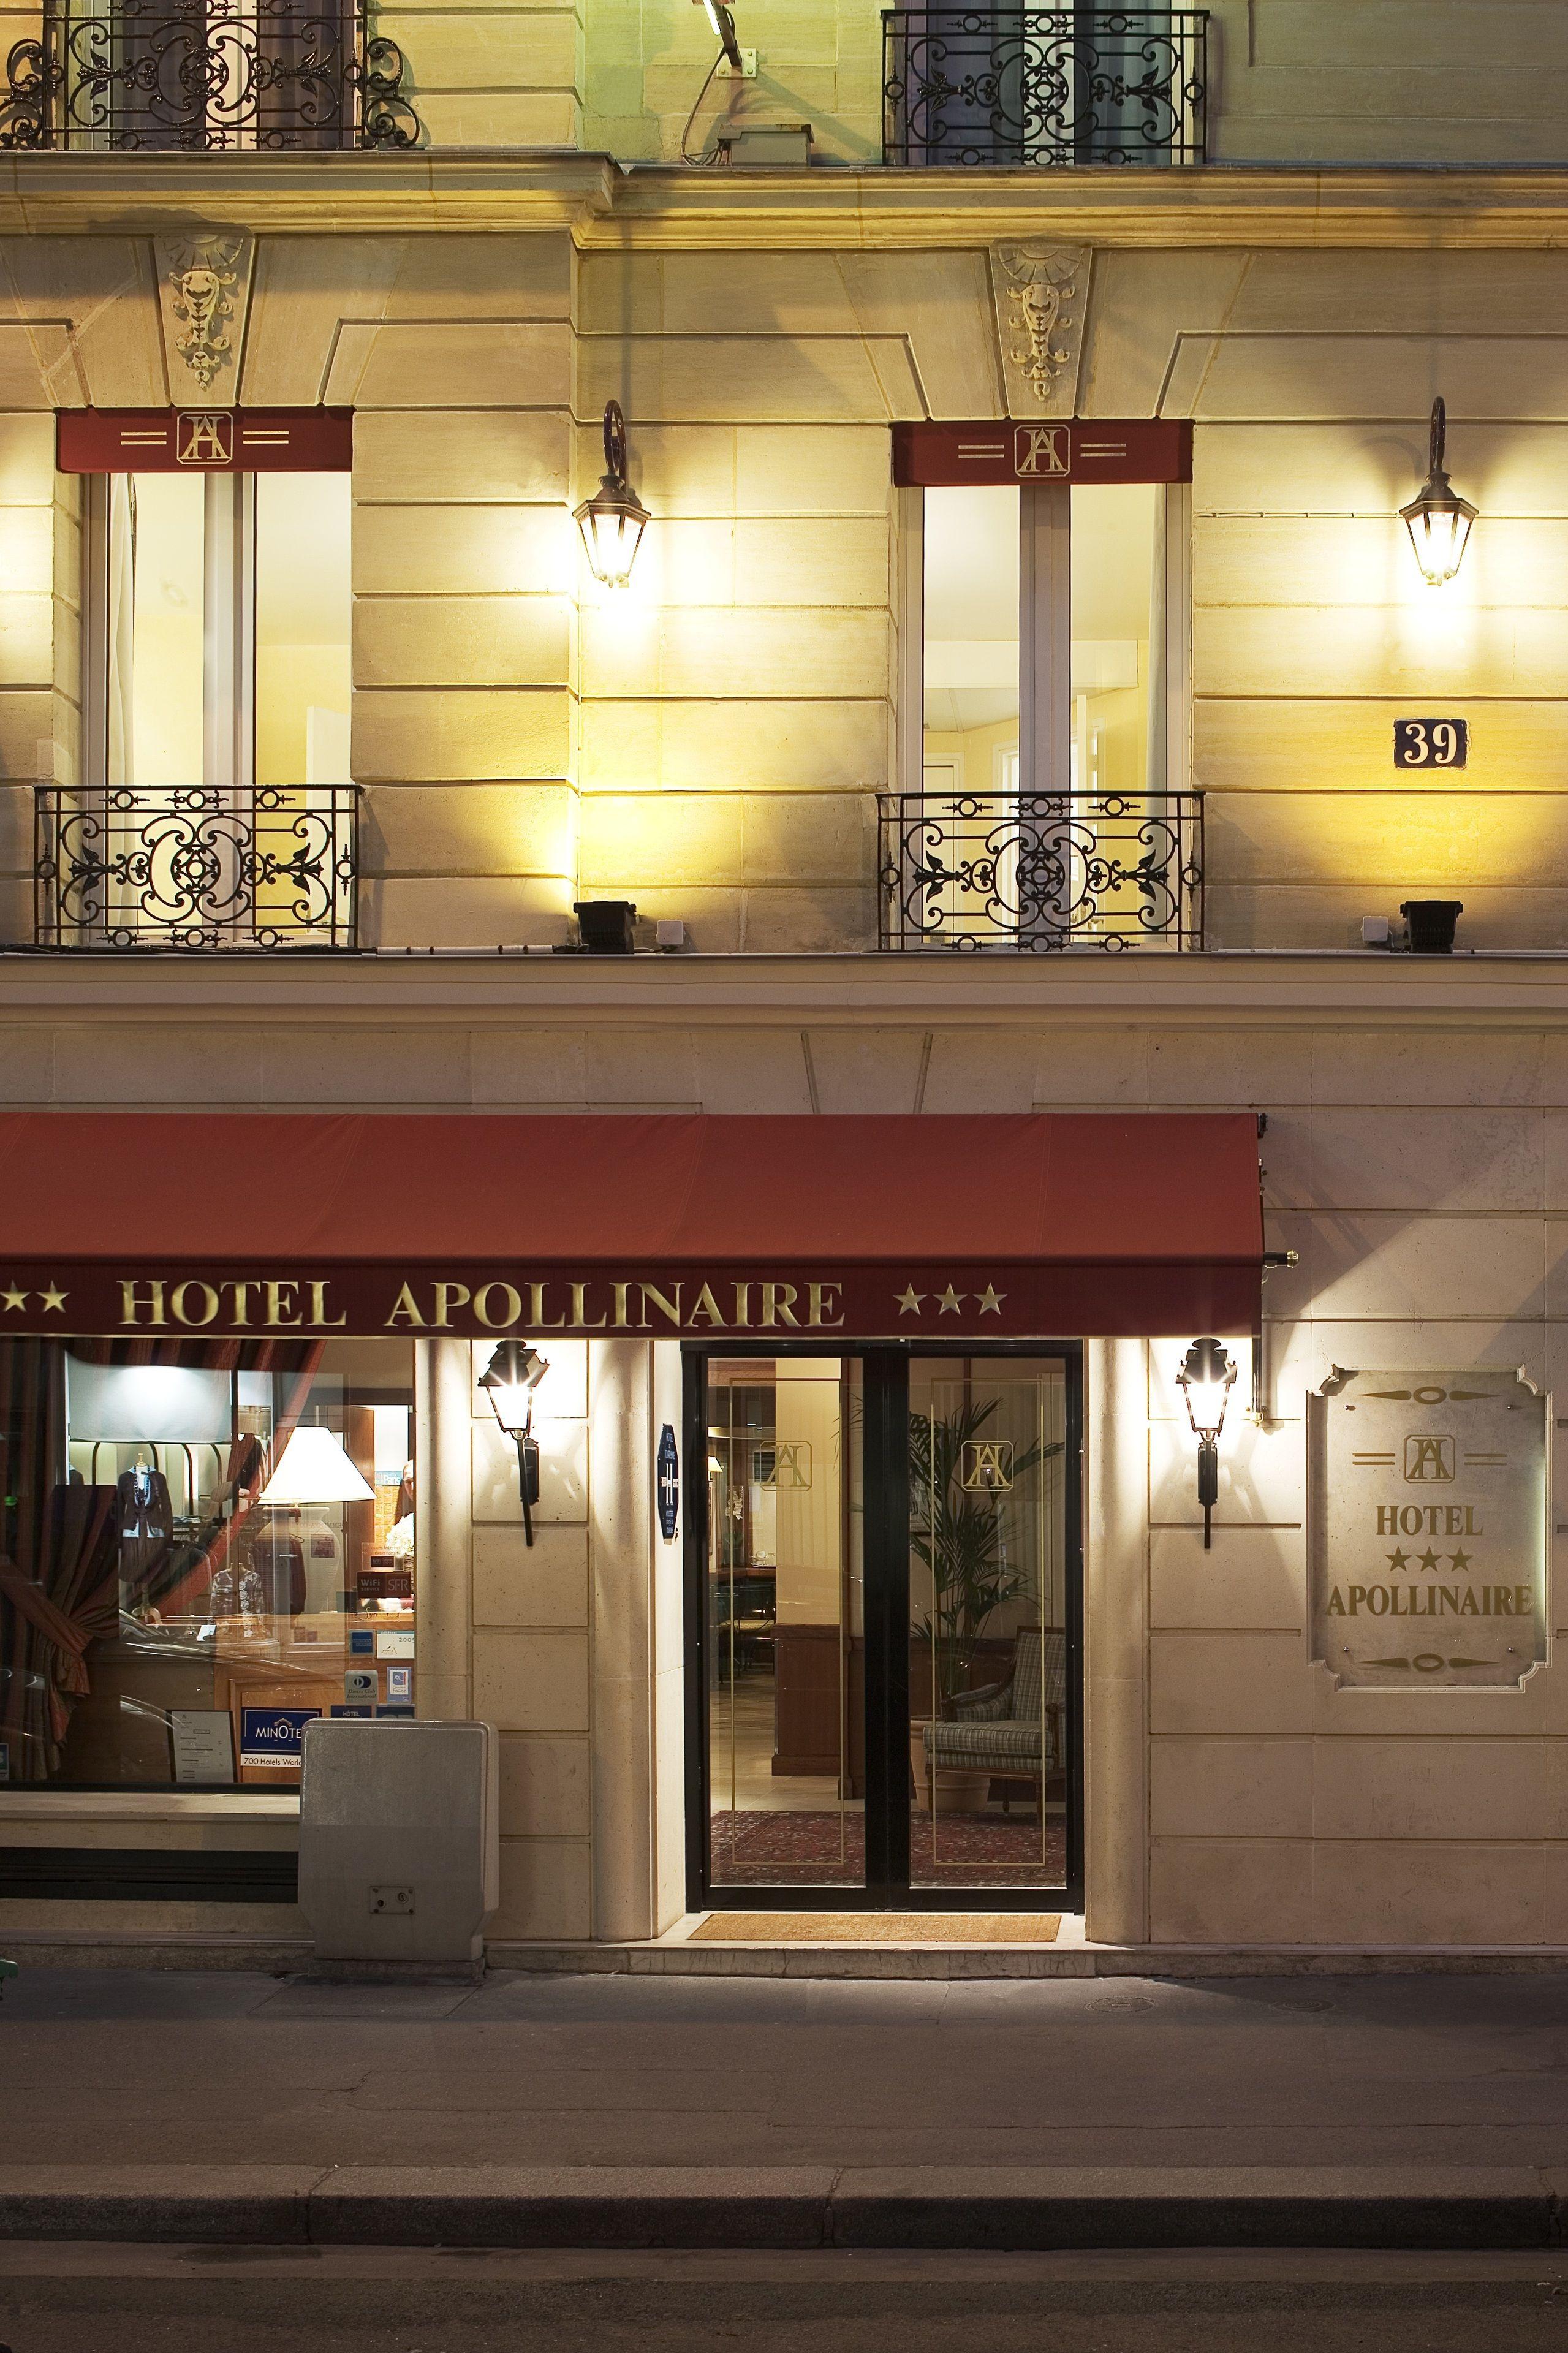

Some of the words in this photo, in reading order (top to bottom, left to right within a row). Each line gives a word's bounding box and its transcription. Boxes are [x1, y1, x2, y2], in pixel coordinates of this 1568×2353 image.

[1404, 723, 1457, 764] 39
[116, 1279, 347, 1327] HOTEL
[383, 1280, 846, 1328] APOLLINAIRE
[1375, 1505, 1483, 1536] HOTEL
[388, 1578, 409, 1592] SFR
[1325, 1585, 1534, 1617] APOLLINAIRE
